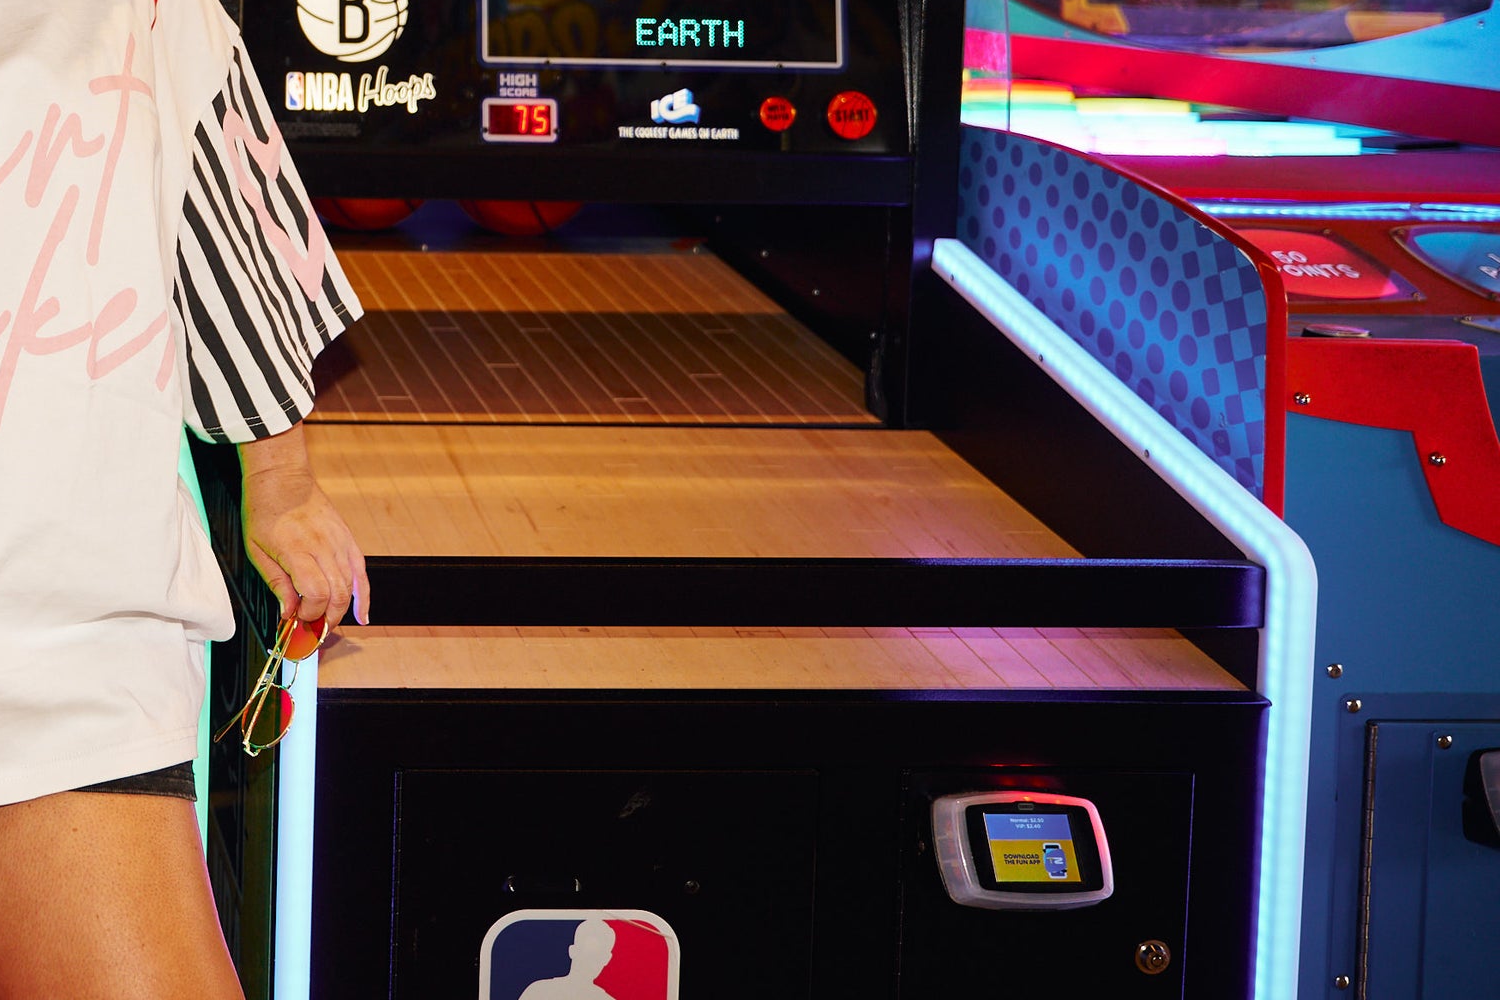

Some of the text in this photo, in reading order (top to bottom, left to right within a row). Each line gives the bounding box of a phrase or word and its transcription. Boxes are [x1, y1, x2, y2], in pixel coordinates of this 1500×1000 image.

[636, 18, 746, 48] EARTH
[499, 73, 537, 86] HIGH
[305, 65, 436, 114] NBA Hoops
[499, 87, 537, 97] SCORE
[651, 88, 700, 124] ICE
[513, 105, 549, 134] 75
[835, 109, 869, 123] START
[618, 126, 634, 138] THE
[635, 126, 668, 139] COOLEST
[669, 126, 698, 139] GAMES
[711, 128, 740, 140] EARTH
[1271, 250, 1308, 265] 50
[1277, 263, 1360, 280] OINTS
